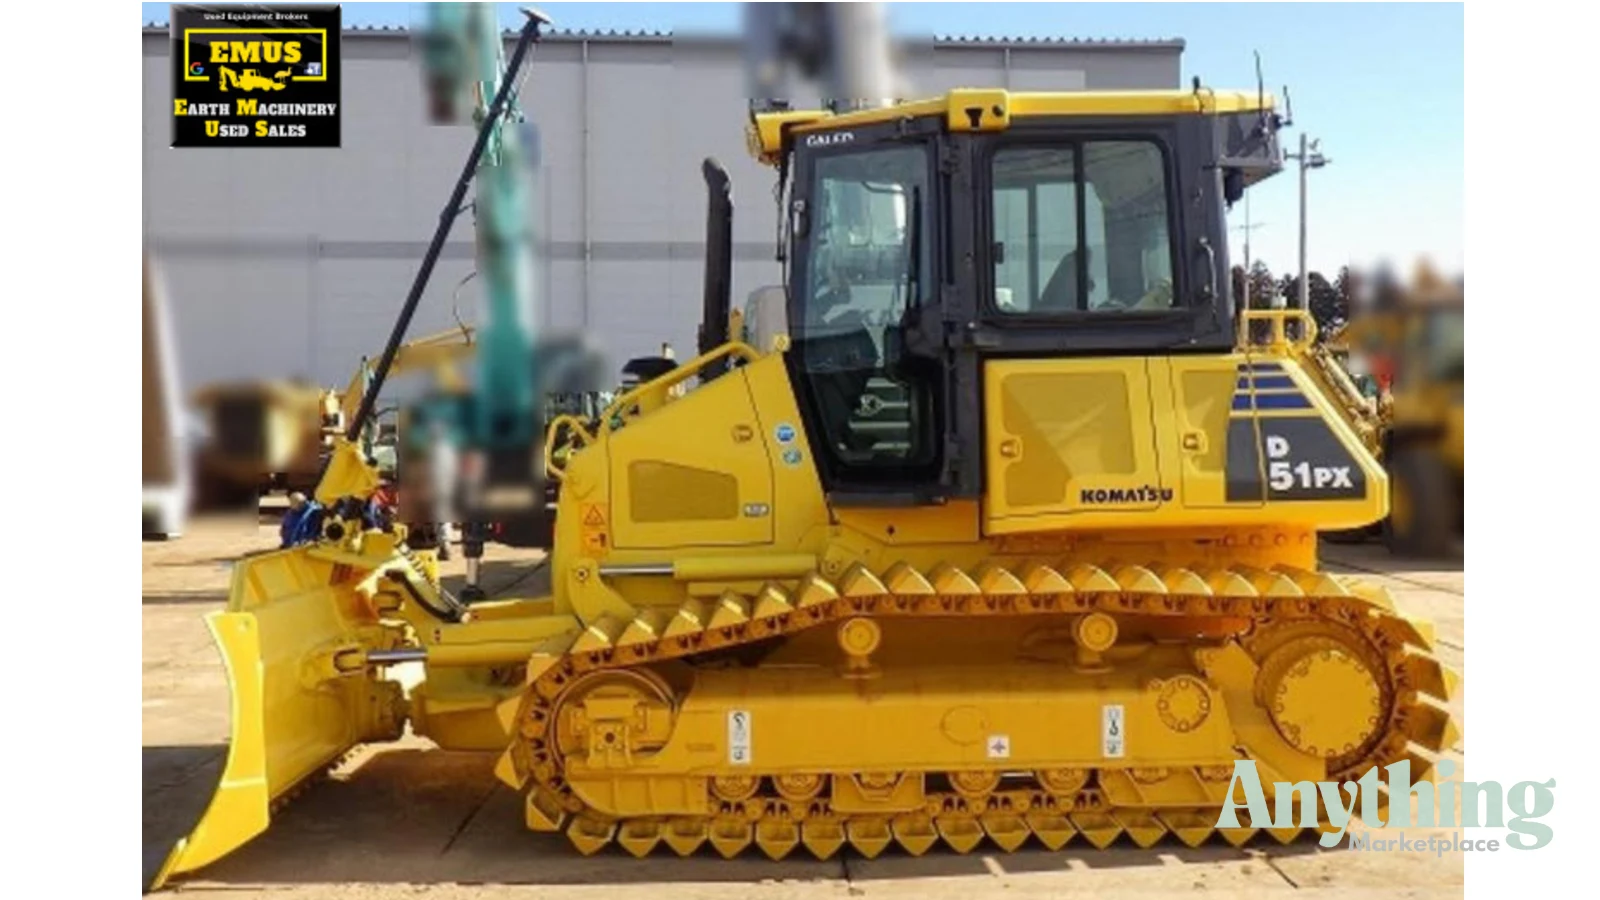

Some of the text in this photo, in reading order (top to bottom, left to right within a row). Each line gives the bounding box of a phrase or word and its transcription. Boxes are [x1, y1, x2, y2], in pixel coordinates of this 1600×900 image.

[1266, 436, 1290, 458] D
[1269, 462, 1352, 491] 51PX
[1081, 485, 1173, 503] KOMATSU
